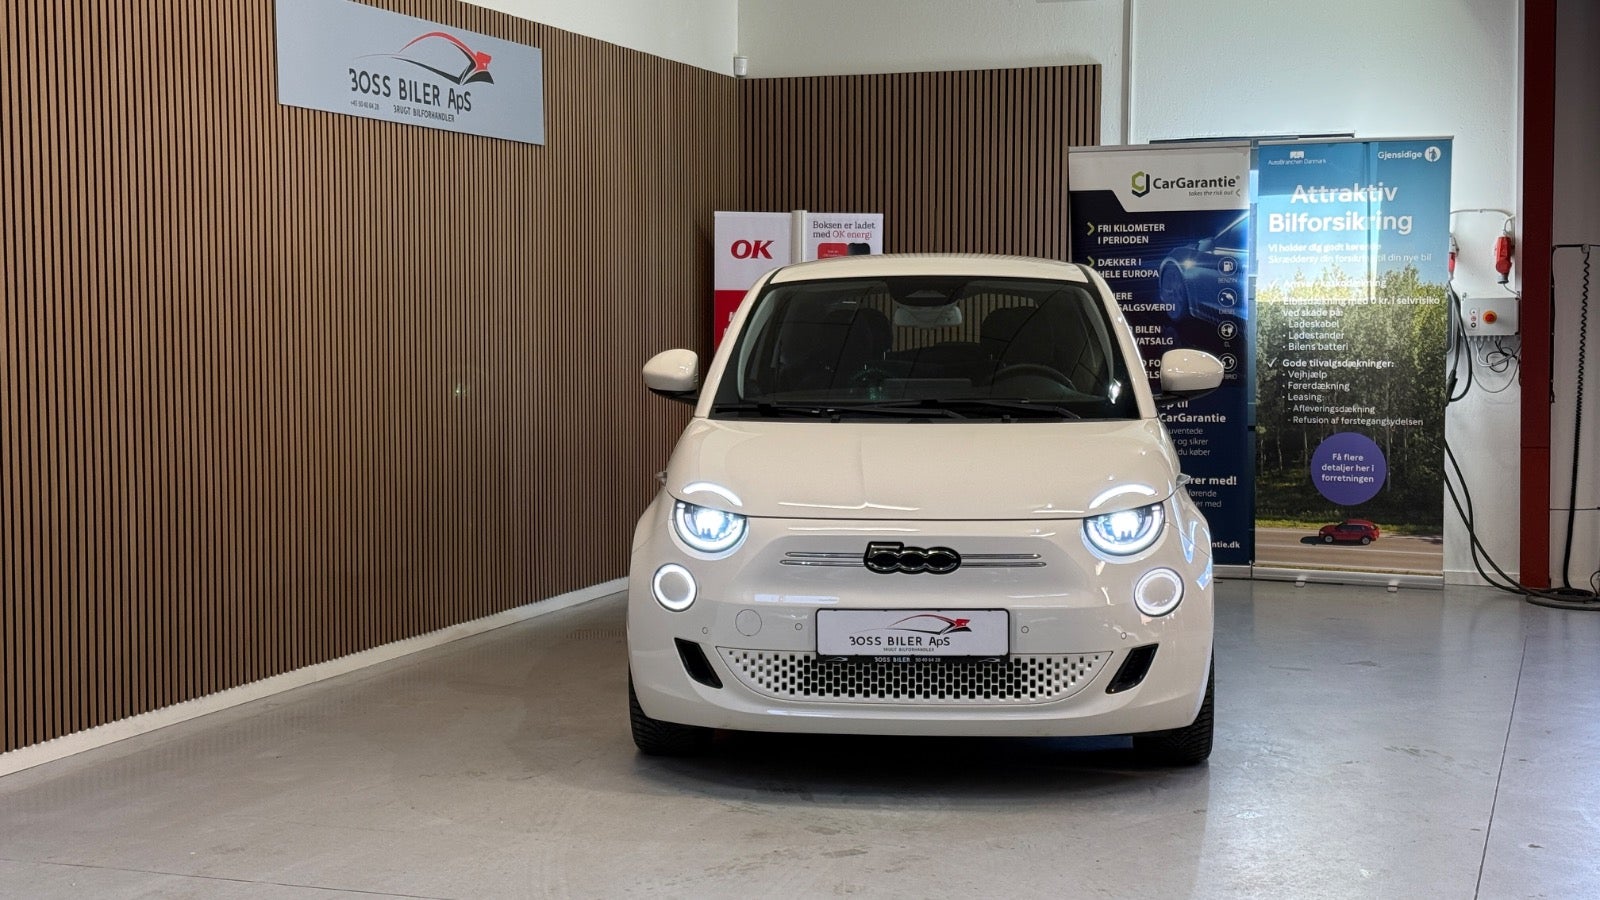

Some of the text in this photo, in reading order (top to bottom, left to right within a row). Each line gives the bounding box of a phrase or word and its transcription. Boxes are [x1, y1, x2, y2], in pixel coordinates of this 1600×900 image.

[399, 78, 440, 106] BILER
[448, 88, 471, 114] ApS
[413, 108, 455, 123] BILFORHANDLER
[1378, 151, 1422, 161] Gjensidige
[1290, 182, 1398, 204] Attraktiv
[813, 221, 842, 229] Boksen
[854, 221, 875, 230] ladet
[1098, 223, 1165, 233] FRI KILOMETER
[1269, 211, 1412, 235] Bilforsikring
[813, 230, 872, 240] med OK energi
[1103, 235, 1149, 244] PERIODEN
[730, 239, 774, 260] OK
[1098, 258, 1137, 267] DÆKKER
[1098, 269, 1160, 279] HELE EUROPA
[1379, 297, 1390, 305] kr.
[1397, 296, 1440, 305] selvrisiko
[1288, 319, 1340, 328] Ladeskabel
[1135, 325, 1161, 334] BILEN
[1288, 331, 1345, 340] Ladestander
[1288, 342, 1349, 351] Bilens batteri
[1282, 359, 1307, 368] Gode
[1288, 370, 1328, 380] Vejhjælp
[1288, 381, 1350, 392] Førerdækning
[1288, 392, 1324, 402] Leasing:
[1293, 404, 1375, 415] Afleveringsdækning
[1160, 413, 1226, 423] CarGarantie
[1293, 416, 1329, 424] Refusion
[1330, 416, 1340, 425] af
[1332, 453, 1364, 462] Få flere
[1321, 464, 1354, 473] detaljer
[1356, 464, 1369, 472] her
[1209, 475, 1237, 486] med!
[1321, 474, 1374, 484] forretningen
[864, 541, 960, 574] 500
[888, 636, 922, 646] BILER
[929, 636, 950, 649] ApS
